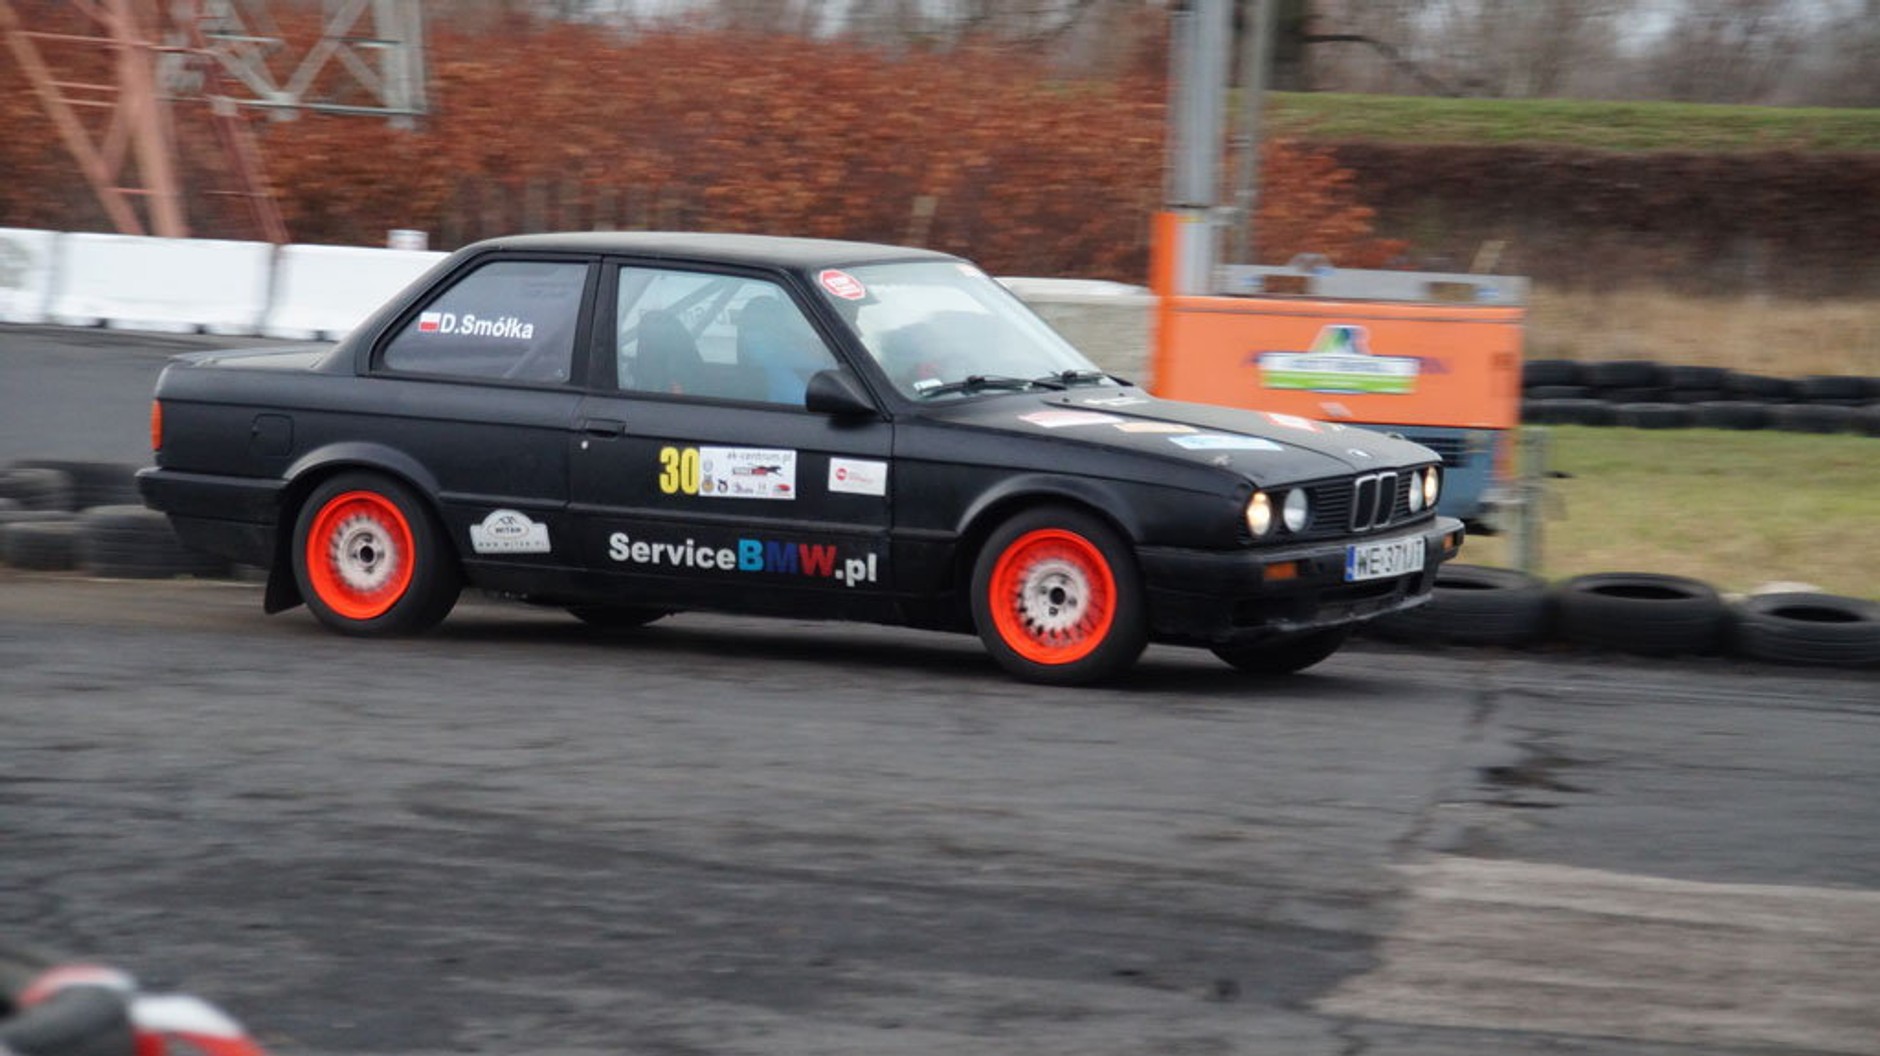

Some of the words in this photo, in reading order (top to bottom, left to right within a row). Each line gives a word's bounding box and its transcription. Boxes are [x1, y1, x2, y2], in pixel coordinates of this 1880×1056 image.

[441, 312, 534, 339] D.Smółka
[659, 446, 700, 495] 30
[608, 532, 878, 588] ServiceBMW.pl
[1357, 547, 1381, 575] WE
